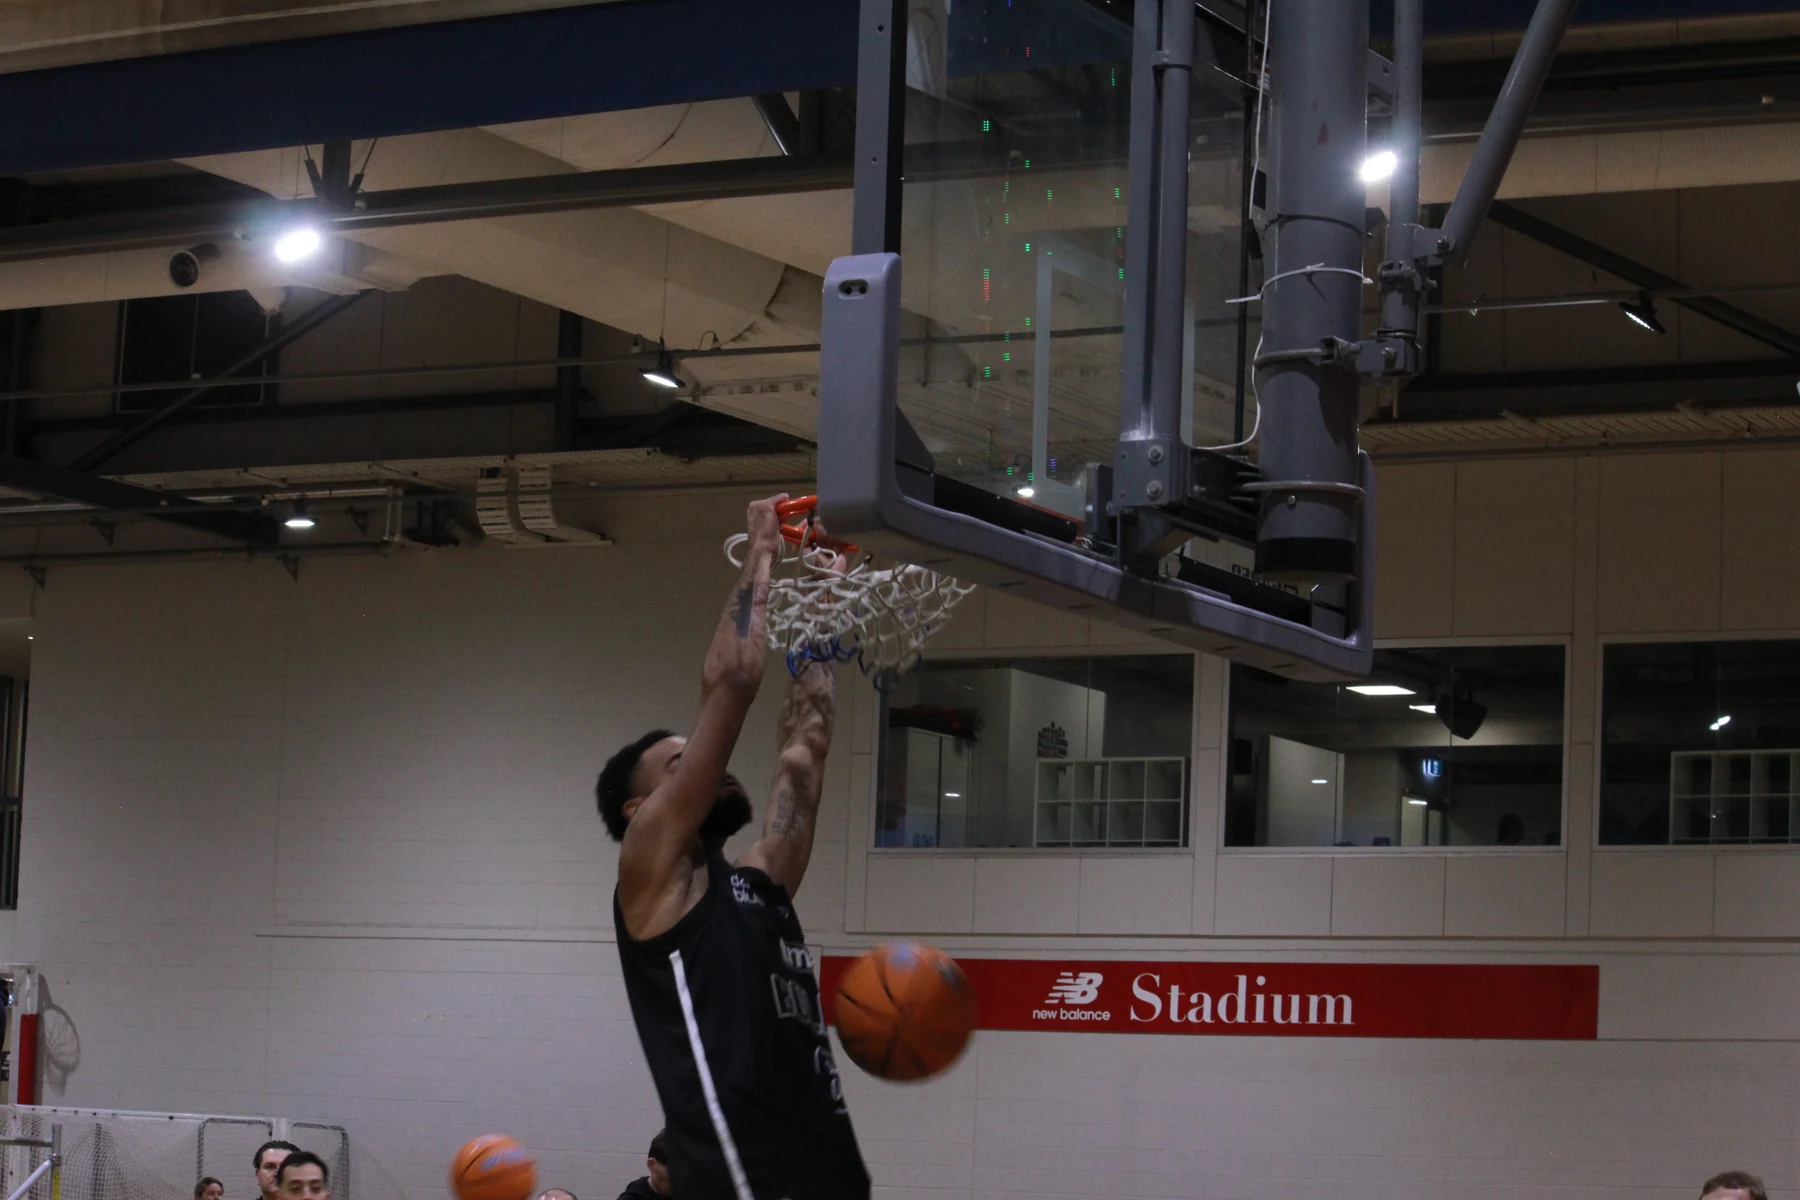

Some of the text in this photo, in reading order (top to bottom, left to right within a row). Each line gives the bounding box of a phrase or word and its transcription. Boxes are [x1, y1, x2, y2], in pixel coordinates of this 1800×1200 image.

[1032, 1007, 1111, 1021] new balance
[1130, 973, 1355, 1025] Stadium
